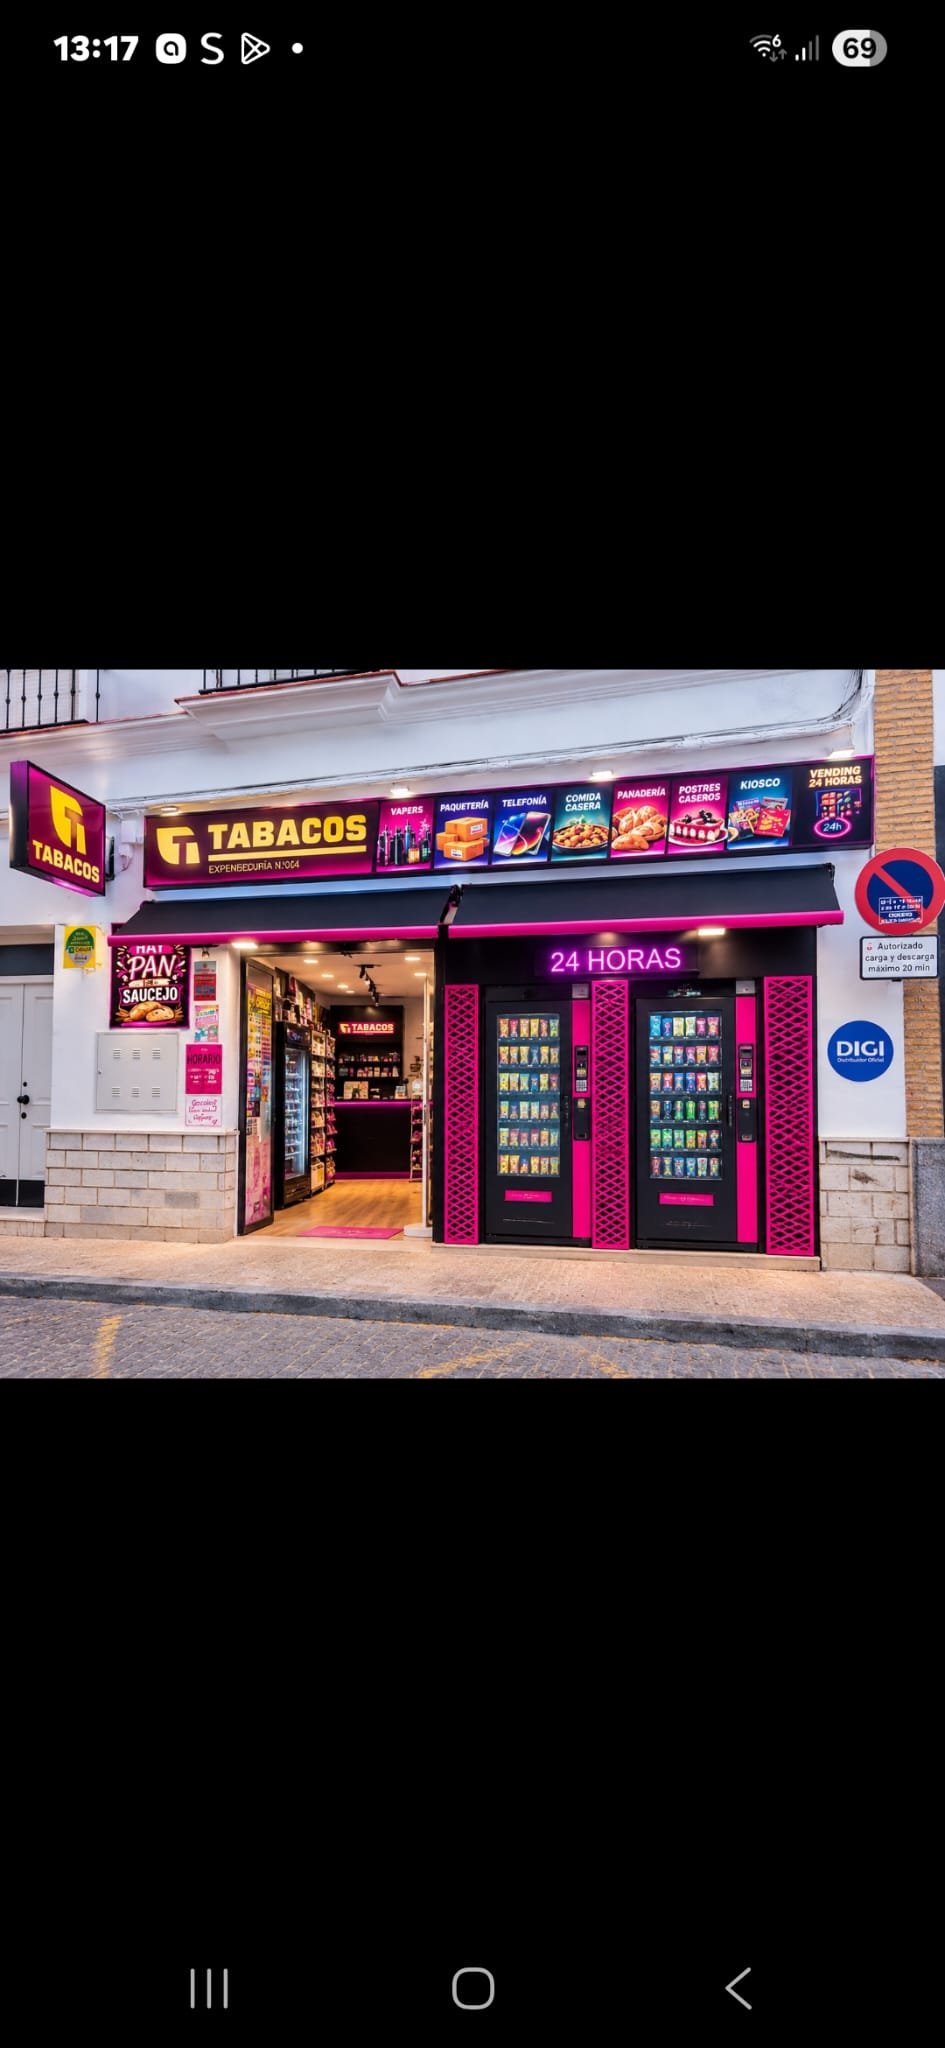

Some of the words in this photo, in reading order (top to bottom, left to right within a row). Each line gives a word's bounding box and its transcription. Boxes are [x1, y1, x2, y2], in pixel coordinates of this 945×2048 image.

[809, 766, 862, 779] VENDING
[678, 782, 721, 795] POSTRES
[740, 777, 781, 791] KIOSCO
[808, 778, 823, 789] 24
[824, 775, 862, 787] HORAS
[565, 792, 602, 803] COMIDA
[617, 785, 666, 800] PANADERÍA
[678, 792, 721, 804] CASEROS
[440, 799, 489, 812] PAQUETERÍA
[502, 795, 547, 808] TELEFONÍA
[565, 801, 601, 812] CASERA
[390, 805, 424, 816] VAPERS
[208, 814, 367, 850] TABACOS
[823, 821, 842, 832] 24h
[32, 840, 100, 884] TABACOS
[878, 941, 923, 951] Autorizado
[550, 952, 579, 973] 24
[588, 947, 682, 971] HORAS
[865, 955, 888, 963] carga
[890, 955, 895, 963] y
[897, 953, 935, 963] descarga
[127, 955, 177, 980] PAN
[868, 964, 900, 973] máximo
[902, 964, 912, 972] 20
[122, 986, 178, 1004] SAUCEJO
[351, 1023, 394, 1031] TABACOS
[837, 1040, 884, 1057] DIGI
[187, 1054, 221, 1065] HORARIO
